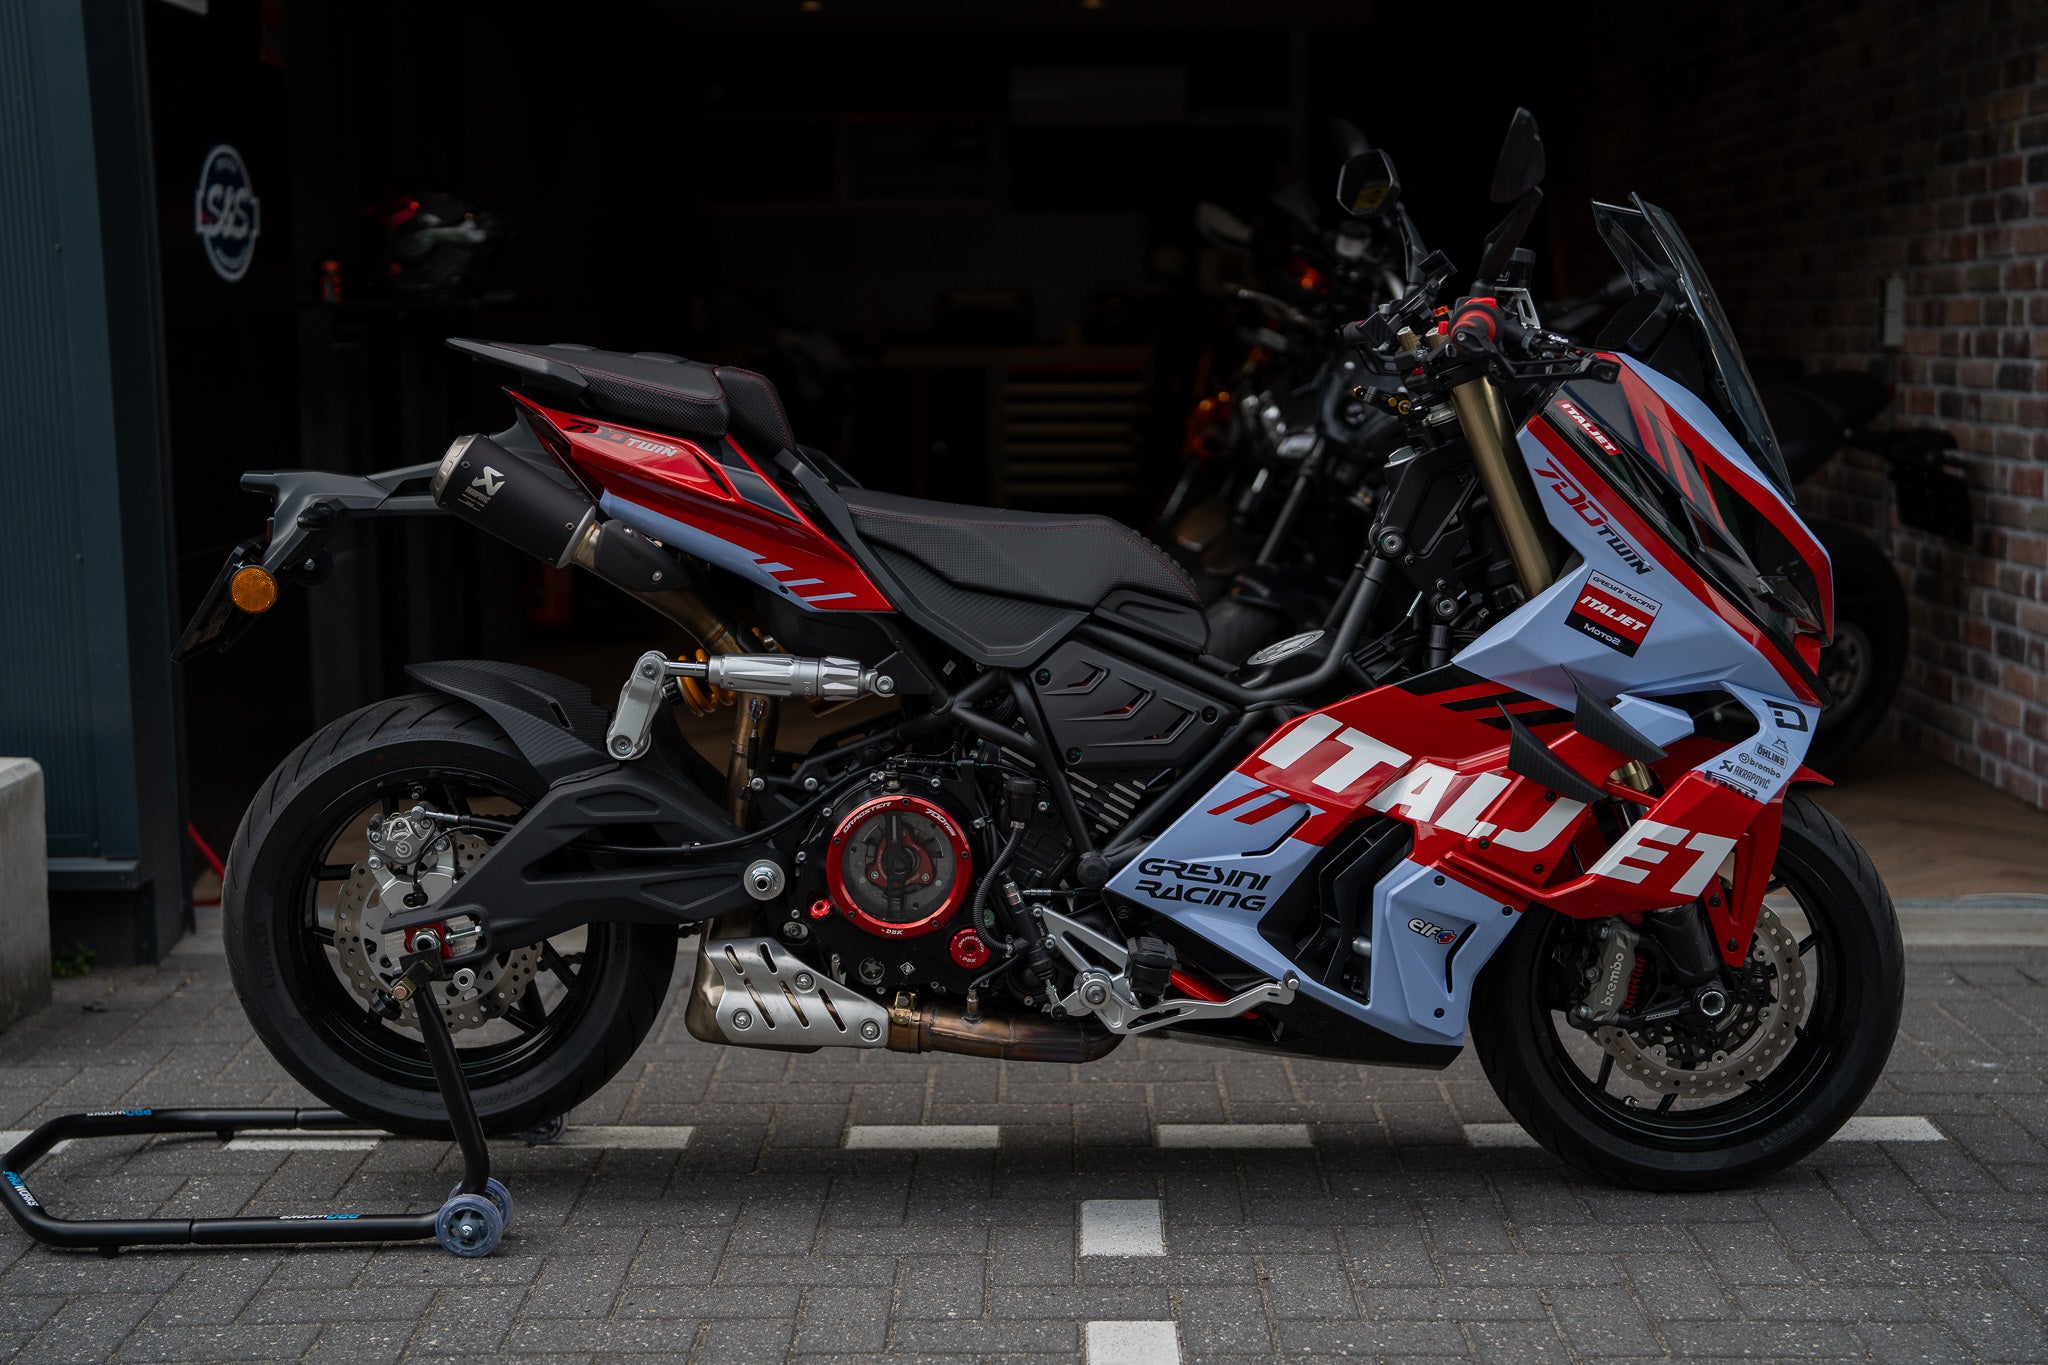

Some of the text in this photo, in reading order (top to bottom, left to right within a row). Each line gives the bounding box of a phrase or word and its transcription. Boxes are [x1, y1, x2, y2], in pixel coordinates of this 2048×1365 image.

[1561, 403, 1616, 451] ITALJET
[626, 438, 679, 457] TWIN
[1597, 524, 1652, 575] TWIN
[1592, 576, 1656, 611] GRESINI RACING
[1580, 595, 1647, 631] ITALJET
[1749, 758, 1781, 779] brembo
[1756, 744, 1787, 767] ÖHLINS
[842, 801, 892, 834] DRAGSTER
[1138, 858, 1272, 891] GRESINI
[1135, 879, 1267, 912] RACING
[1408, 918, 1442, 938] elf
[1601, 953, 1625, 1006] brembo
